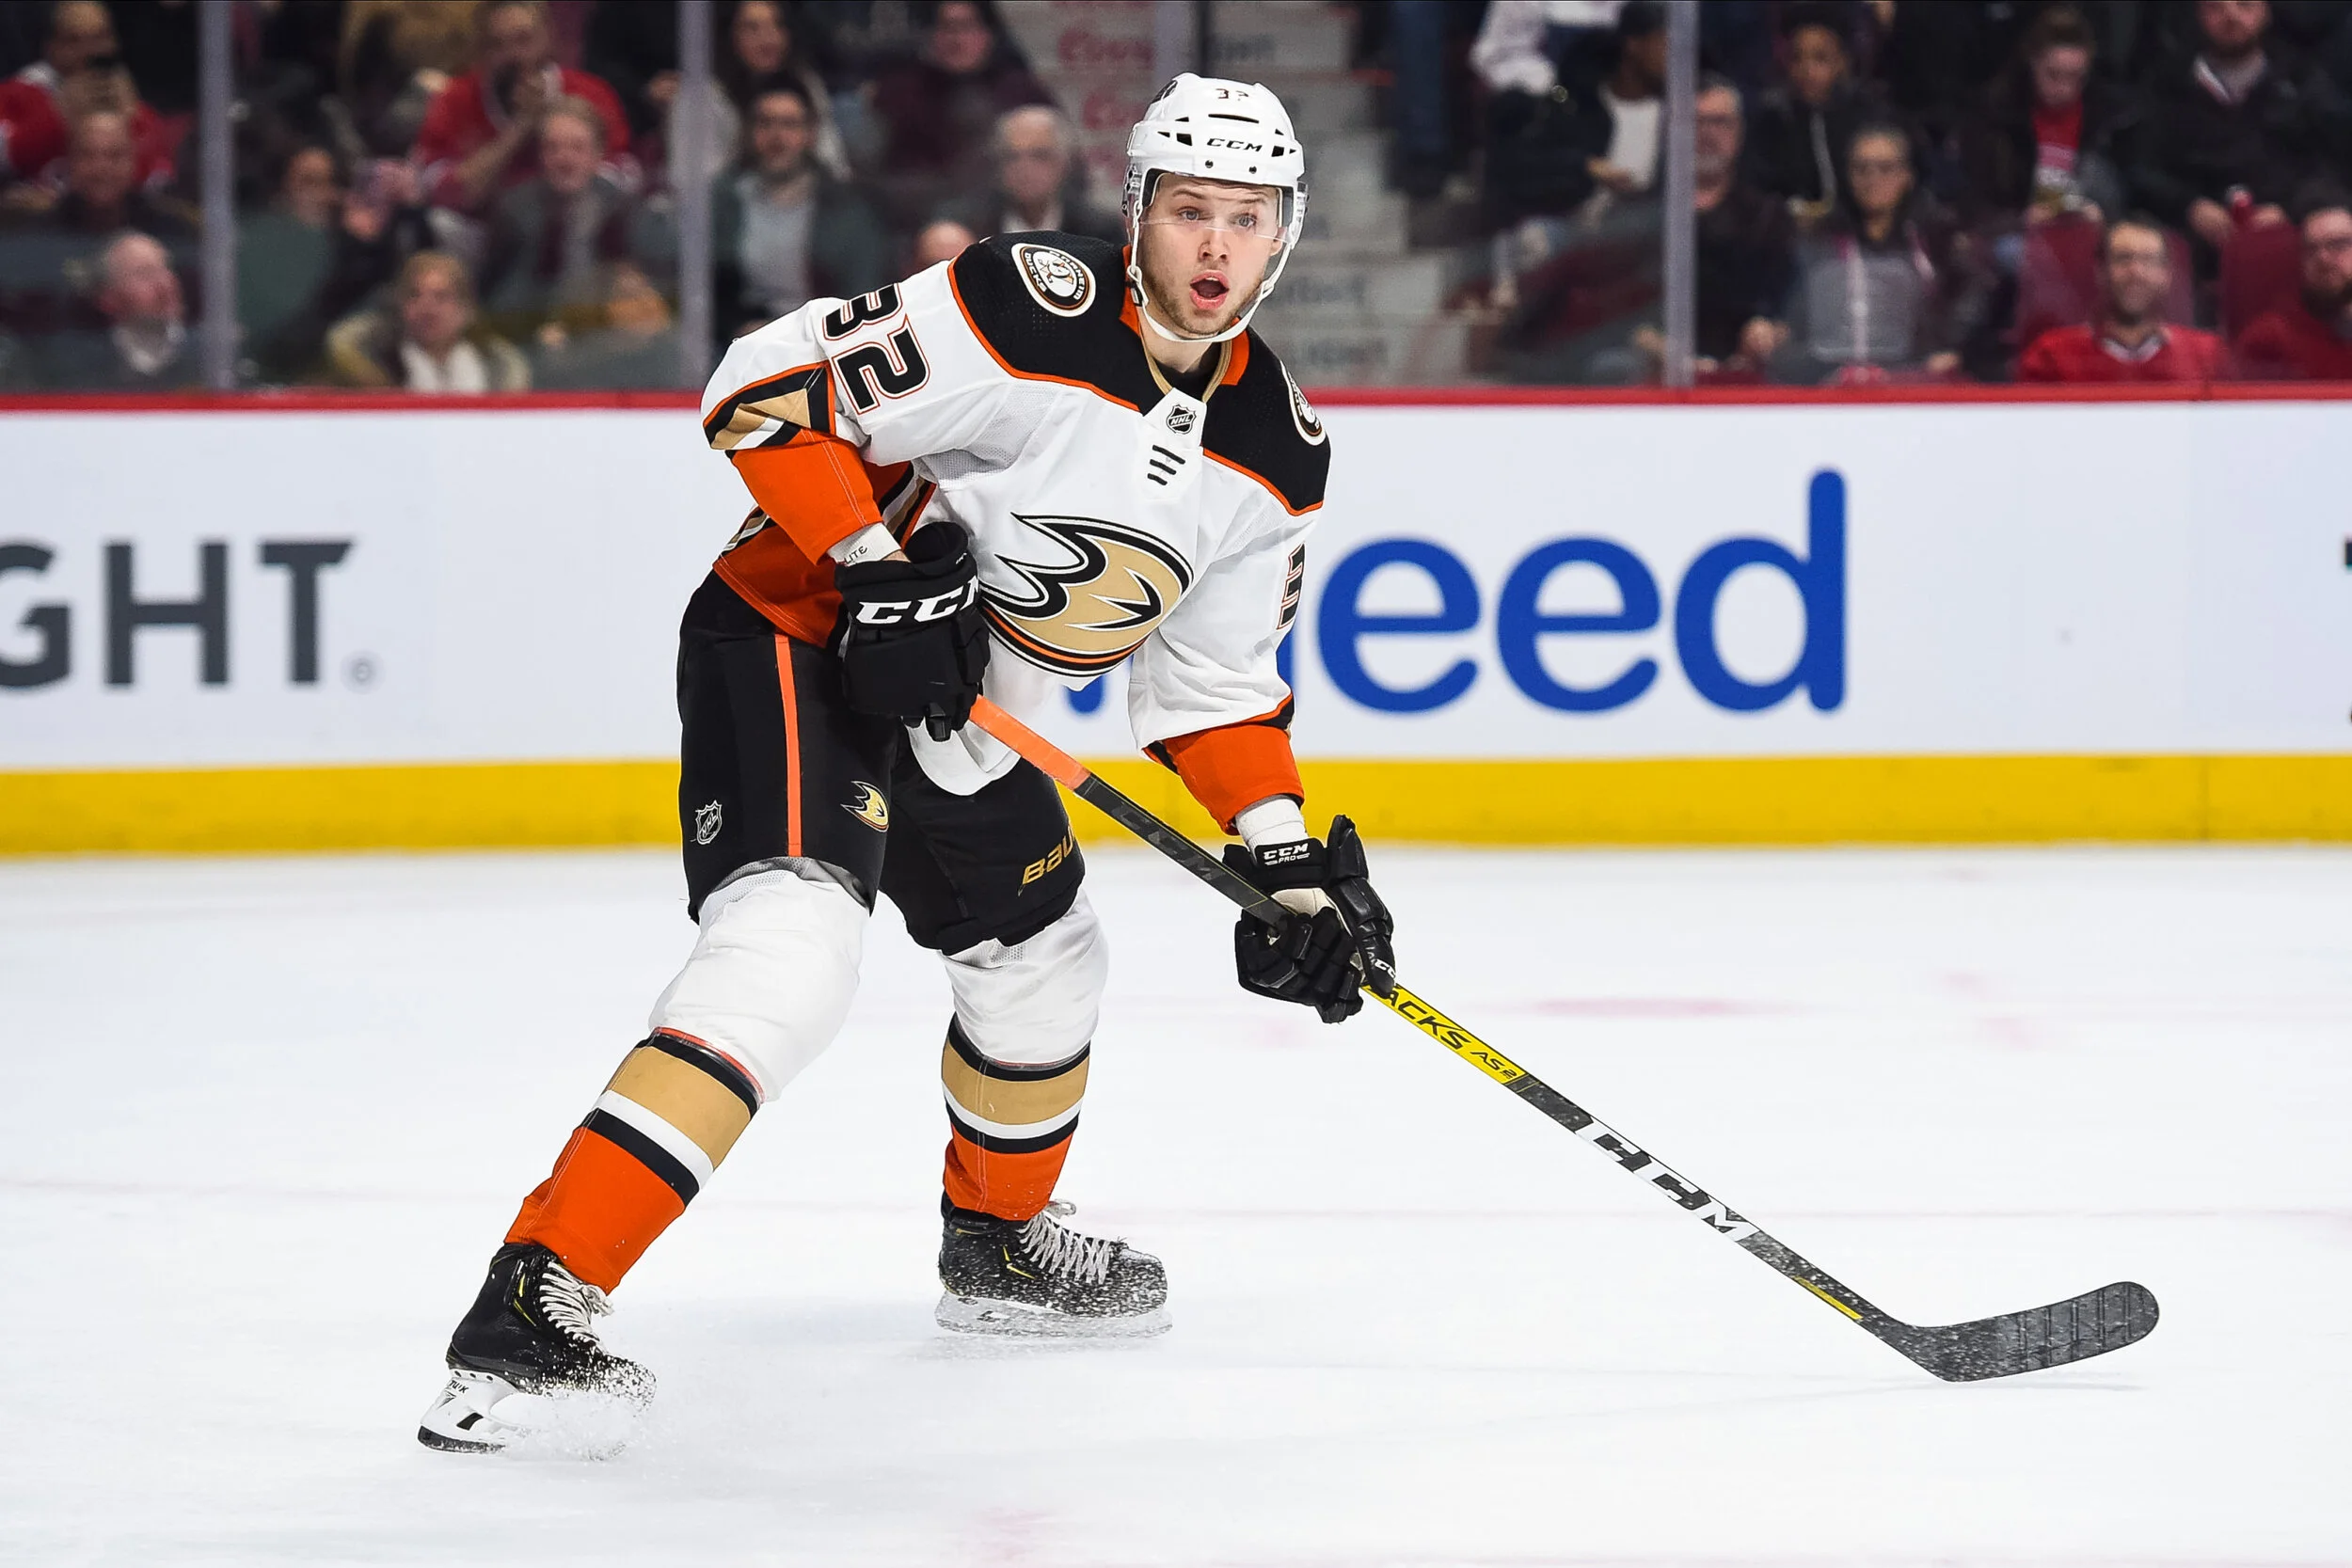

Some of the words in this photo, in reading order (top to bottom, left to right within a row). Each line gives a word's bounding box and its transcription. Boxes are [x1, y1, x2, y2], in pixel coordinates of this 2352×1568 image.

[1206, 137, 1263, 152] CCM
[1025, 252, 1048, 293] DUCKS
[821, 282, 931, 415] 32
[1170, 415, 1191, 426] NHL
[1067, 468, 1847, 714] eed
[1263, 843, 1309, 861] CCM
[1278, 855, 1296, 863] PRO
[1374, 958, 1397, 979] CC
[1387, 990, 1472, 1051] ACKS
[1574, 1115, 1762, 1243] CCM
